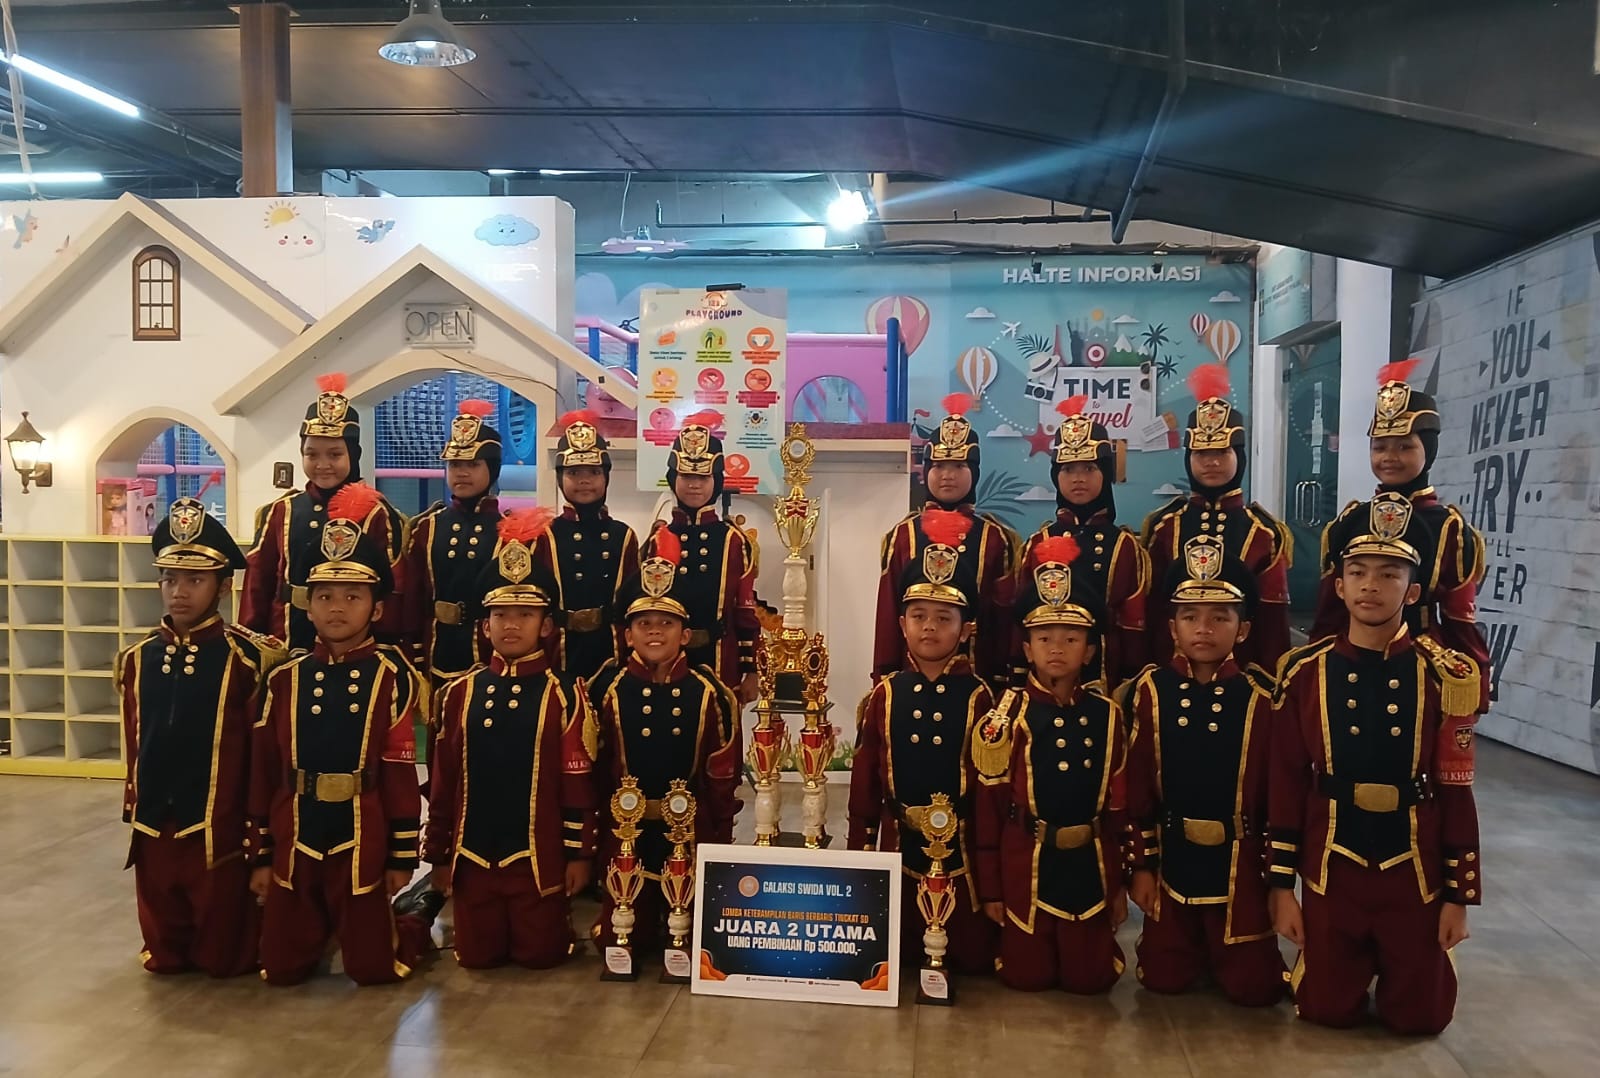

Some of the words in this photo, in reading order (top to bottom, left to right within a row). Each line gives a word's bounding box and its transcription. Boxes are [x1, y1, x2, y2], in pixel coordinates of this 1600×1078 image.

[1002, 267, 1071, 284] HALTE
[1078, 265, 1201, 283] INFORMASI
[1507, 284, 1527, 318] IF
[405, 311, 470, 337] OPEN
[686, 309, 743, 321] PLAYGROUND
[1489, 319, 1536, 390] YOU
[1063, 378, 1131, 400] TIME
[1468, 380, 1550, 455] NEVER
[762, 880, 796, 894] GALAKSI
[798, 882, 825, 896] SWIDA
[846, 885, 853, 898] 2
[722, 907, 743, 918] LOMBA
[743, 908, 787, 919] KETERAMPILAN
[834, 913, 860, 923] TINGKAT
[713, 919, 781, 936] JUARA
[787, 922, 799, 937] 2
[805, 924, 878, 942] UTAMA
[727, 935, 751, 948] UANG
[752, 937, 802, 951] PEMBINAAN
[804, 940, 816, 954] Rp
